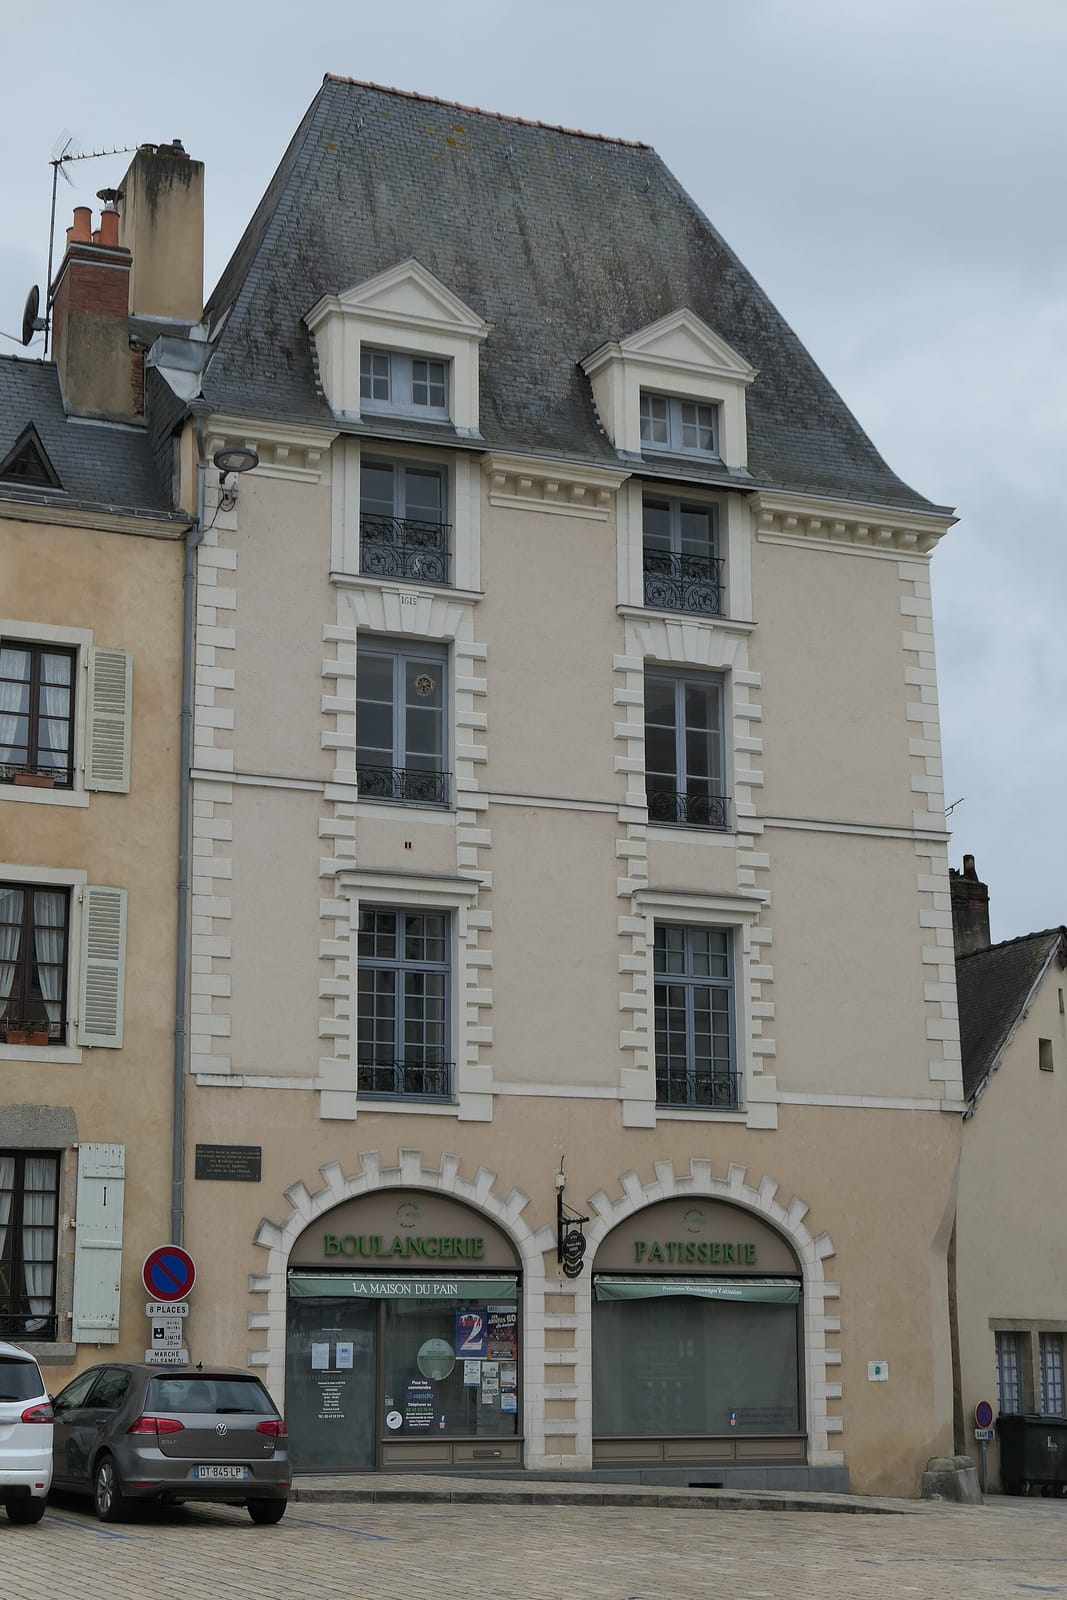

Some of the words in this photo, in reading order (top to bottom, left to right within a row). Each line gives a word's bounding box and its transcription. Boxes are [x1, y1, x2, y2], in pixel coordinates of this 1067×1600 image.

[324, 1233, 485, 1260] BOULANGERIE
[635, 1240, 758, 1265] PATISSERIE
[352, 1283, 367, 1293] LA
[370, 1283, 411, 1295] MAISON
[416, 1284, 431, 1295] DU
[434, 1284, 458, 1295] PAIN
